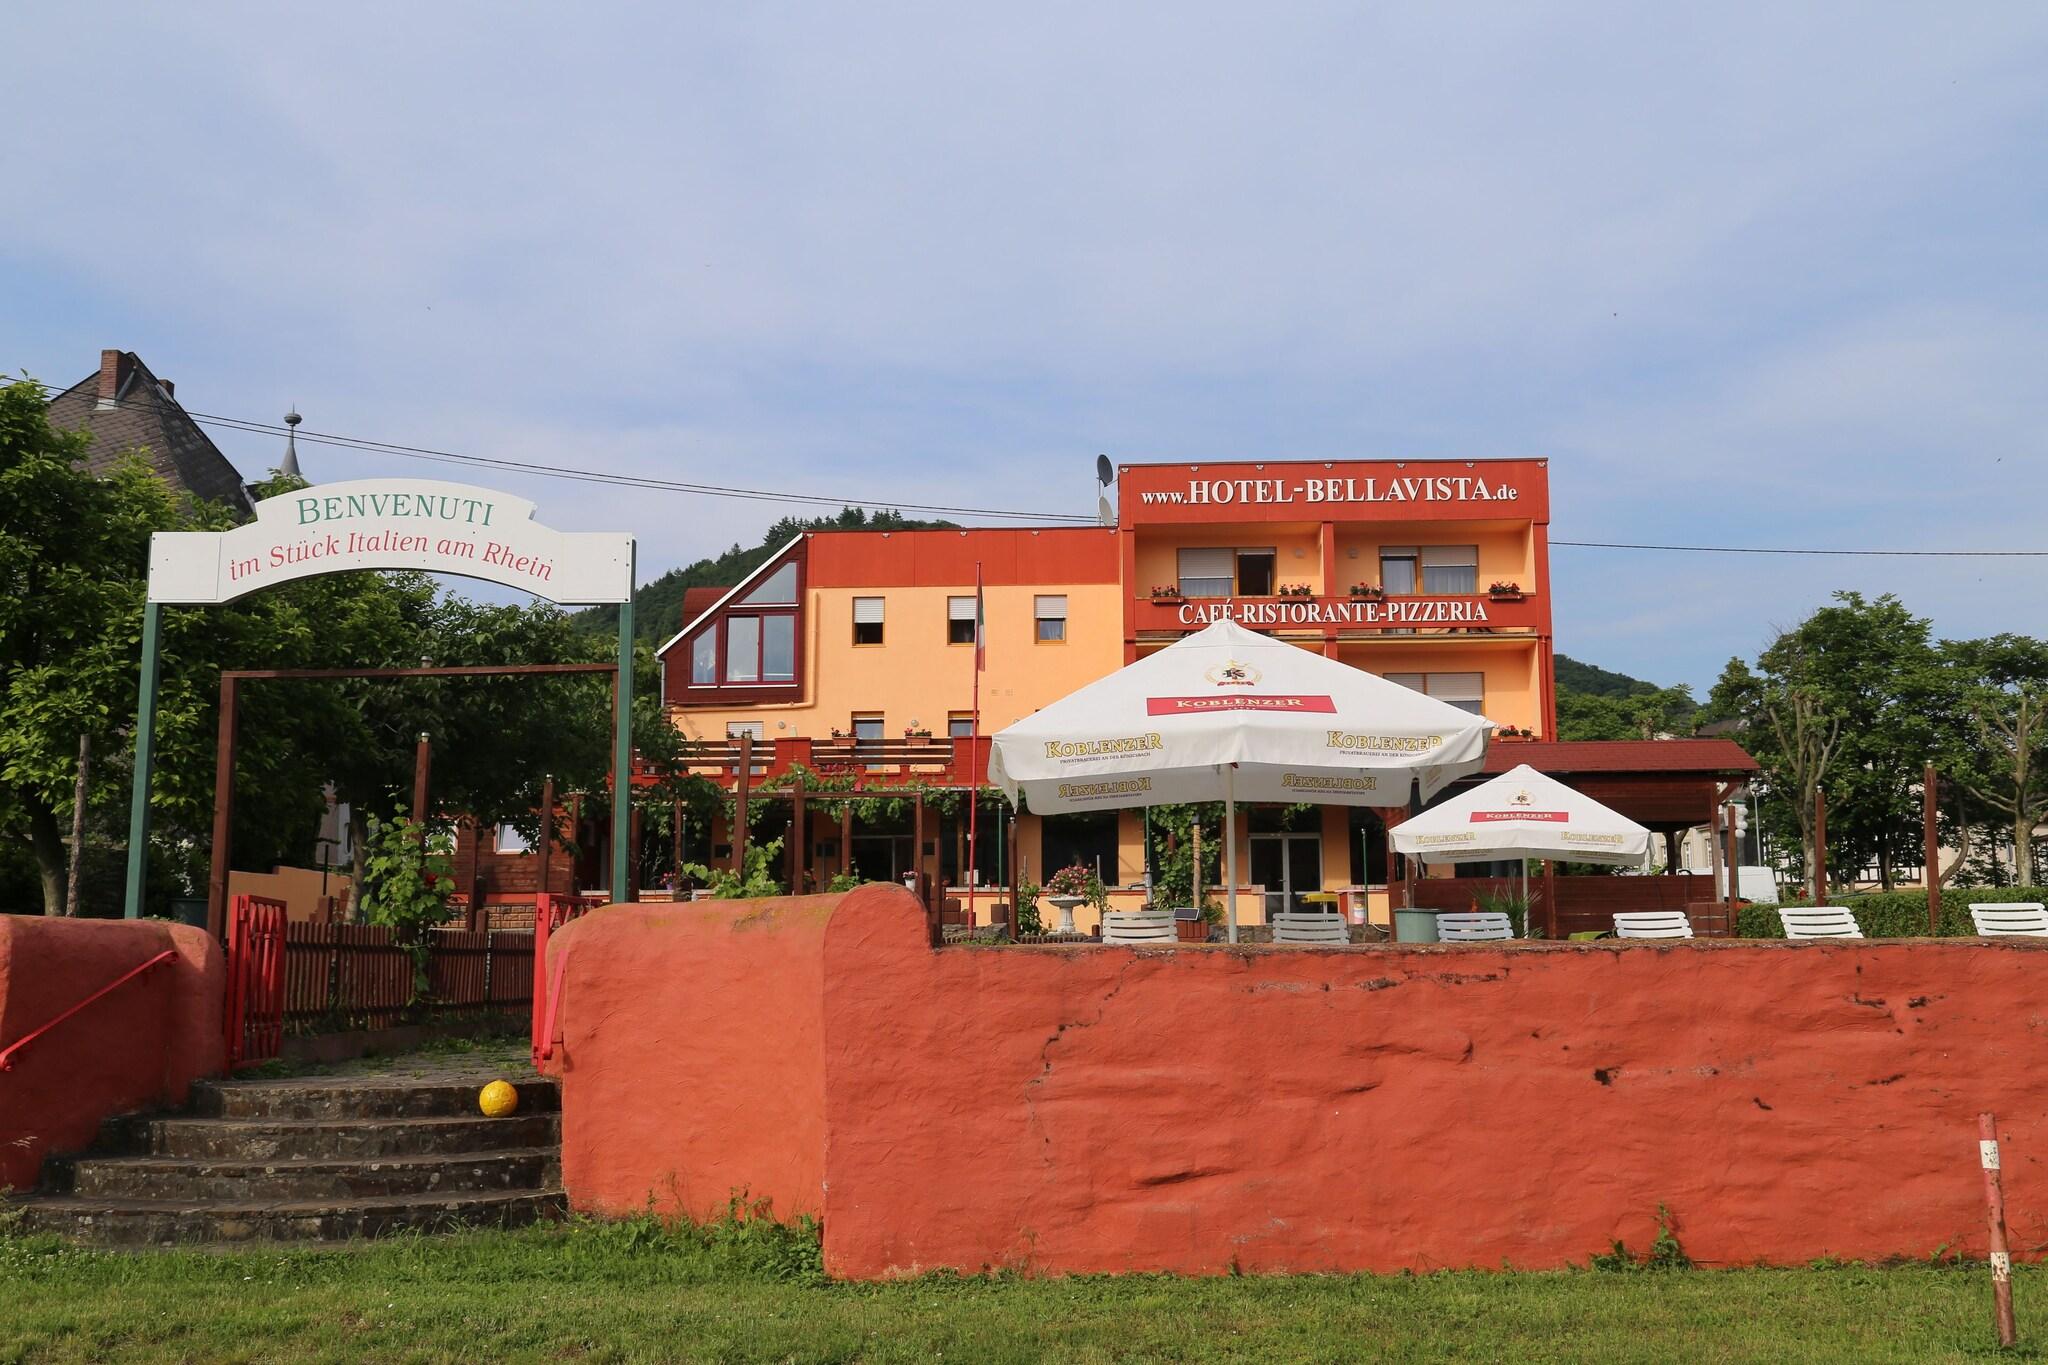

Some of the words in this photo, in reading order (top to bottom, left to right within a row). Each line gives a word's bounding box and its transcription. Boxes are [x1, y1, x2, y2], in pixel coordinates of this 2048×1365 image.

[1141, 477, 1518, 504] www.HOTEL-BELLAVISTA.de
[296, 494, 494, 526] BENVENUTI
[230, 557, 261, 581] im
[270, 534, 340, 568] Stück
[348, 530, 428, 553] Italien
[437, 538, 475, 559] am
[482, 541, 552, 581] Rhein
[1178, 599, 1488, 624] CAFÉ-RISTORANTE-PIZZERIA
[1177, 698, 1304, 708] KOBLENZER
[1045, 732, 1163, 758] KOBLENZER
